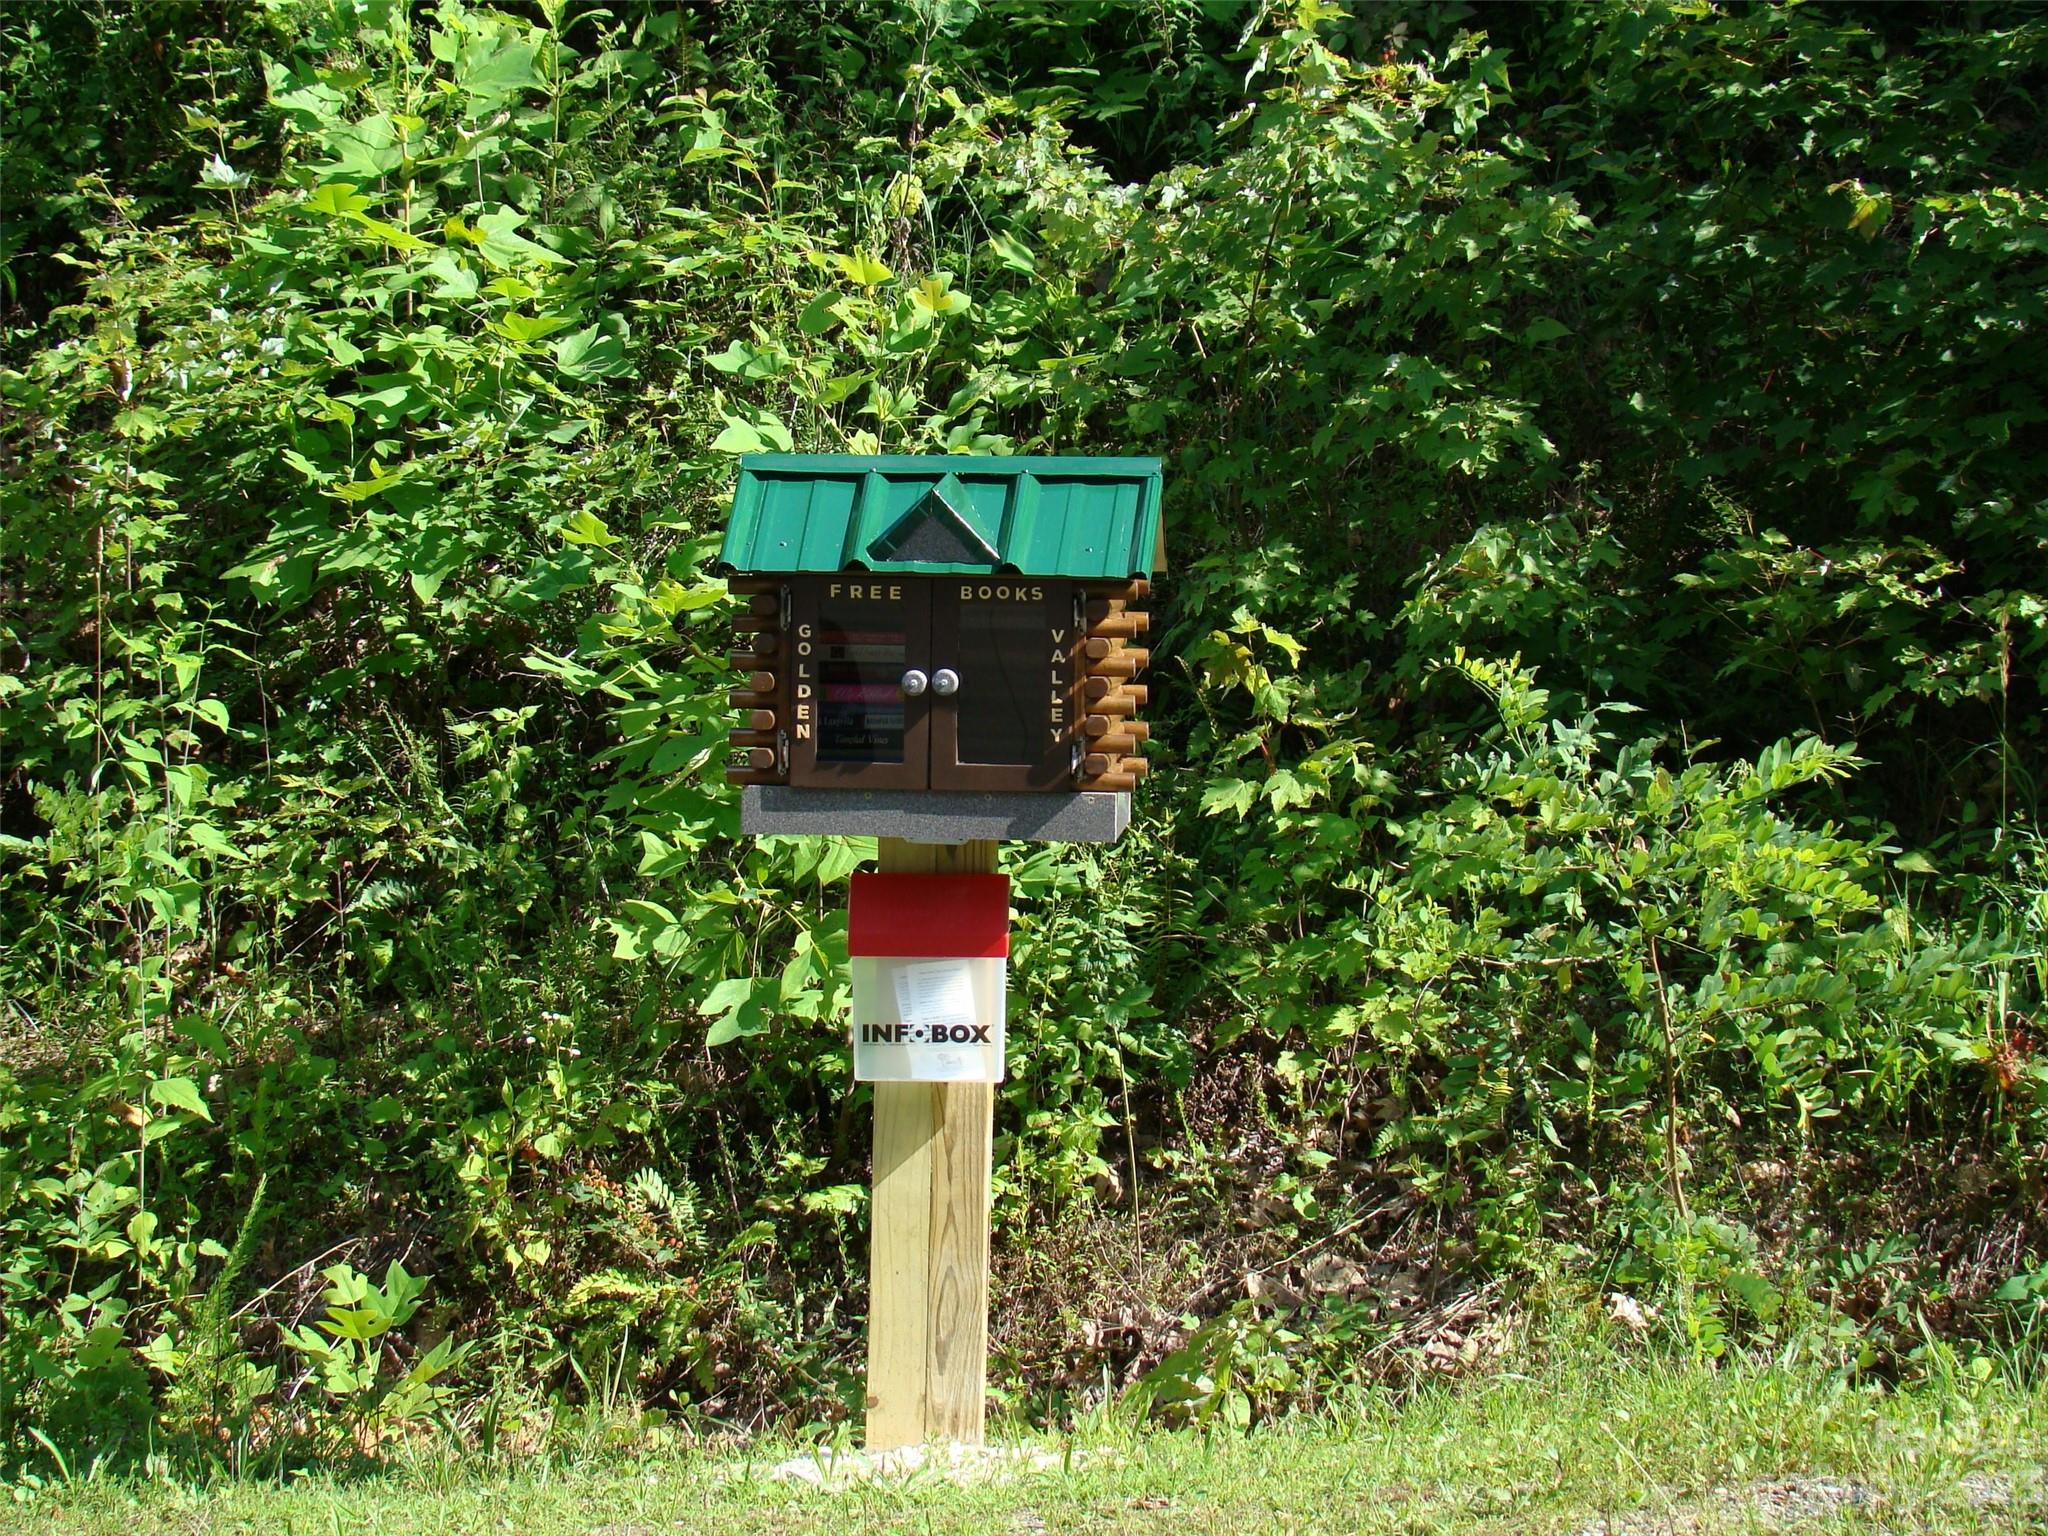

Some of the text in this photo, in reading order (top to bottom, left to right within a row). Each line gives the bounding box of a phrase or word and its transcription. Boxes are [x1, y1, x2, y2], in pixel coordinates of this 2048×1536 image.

[830, 585, 1044, 601] FREE BOOKS
[796, 624, 812, 740] GOLDEN
[1050, 629, 1067, 744] VALLEY
